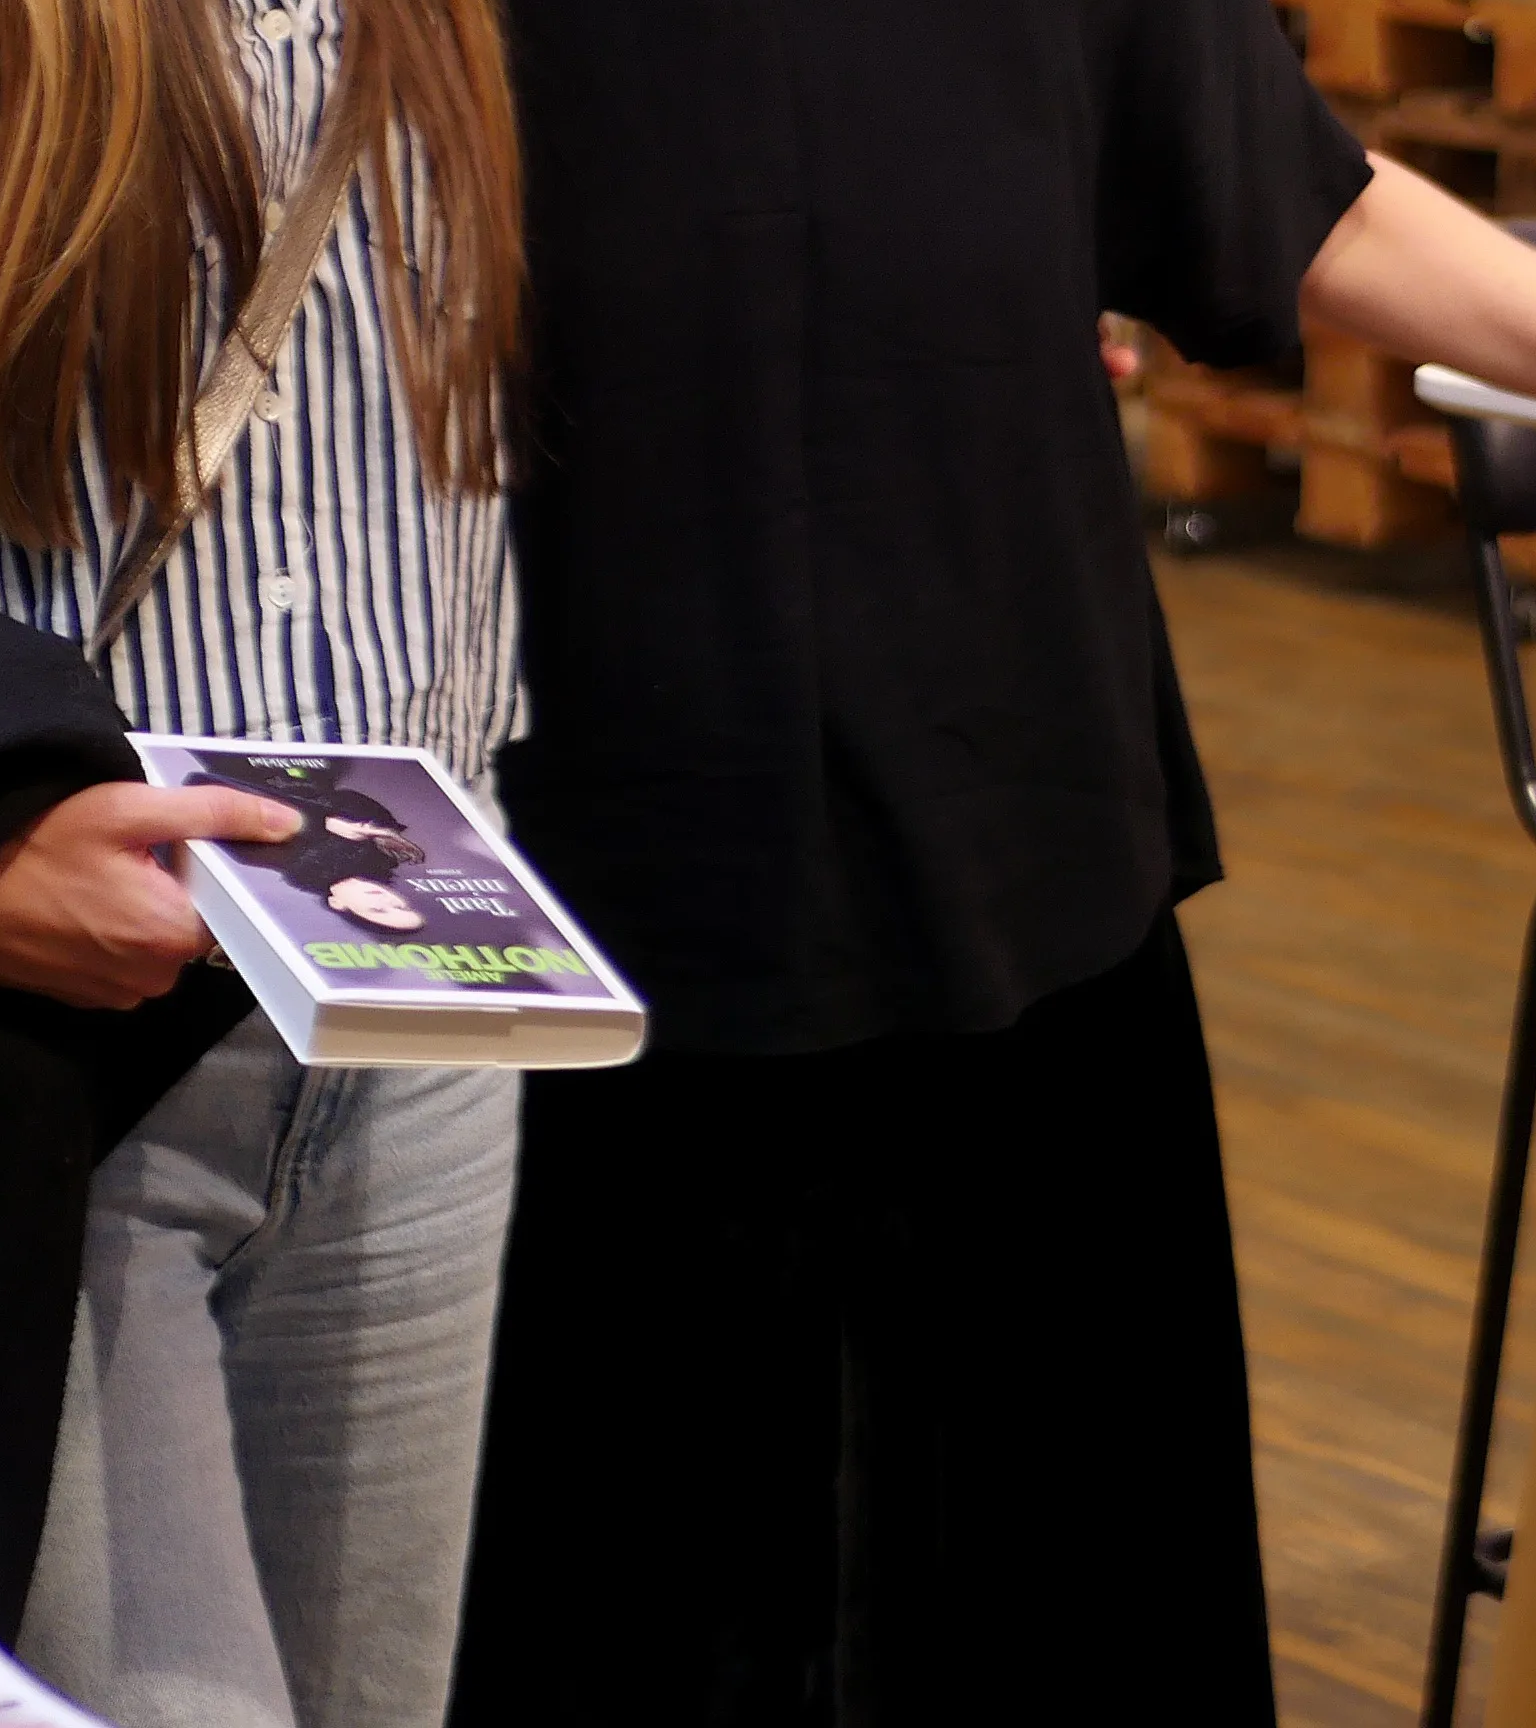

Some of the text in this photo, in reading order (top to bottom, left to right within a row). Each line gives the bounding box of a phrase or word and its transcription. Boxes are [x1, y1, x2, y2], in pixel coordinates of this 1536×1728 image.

[406, 878, 509, 896] mieux
[436, 896, 520, 917] Tant
[302, 940, 589, 976] NOTHOMB
